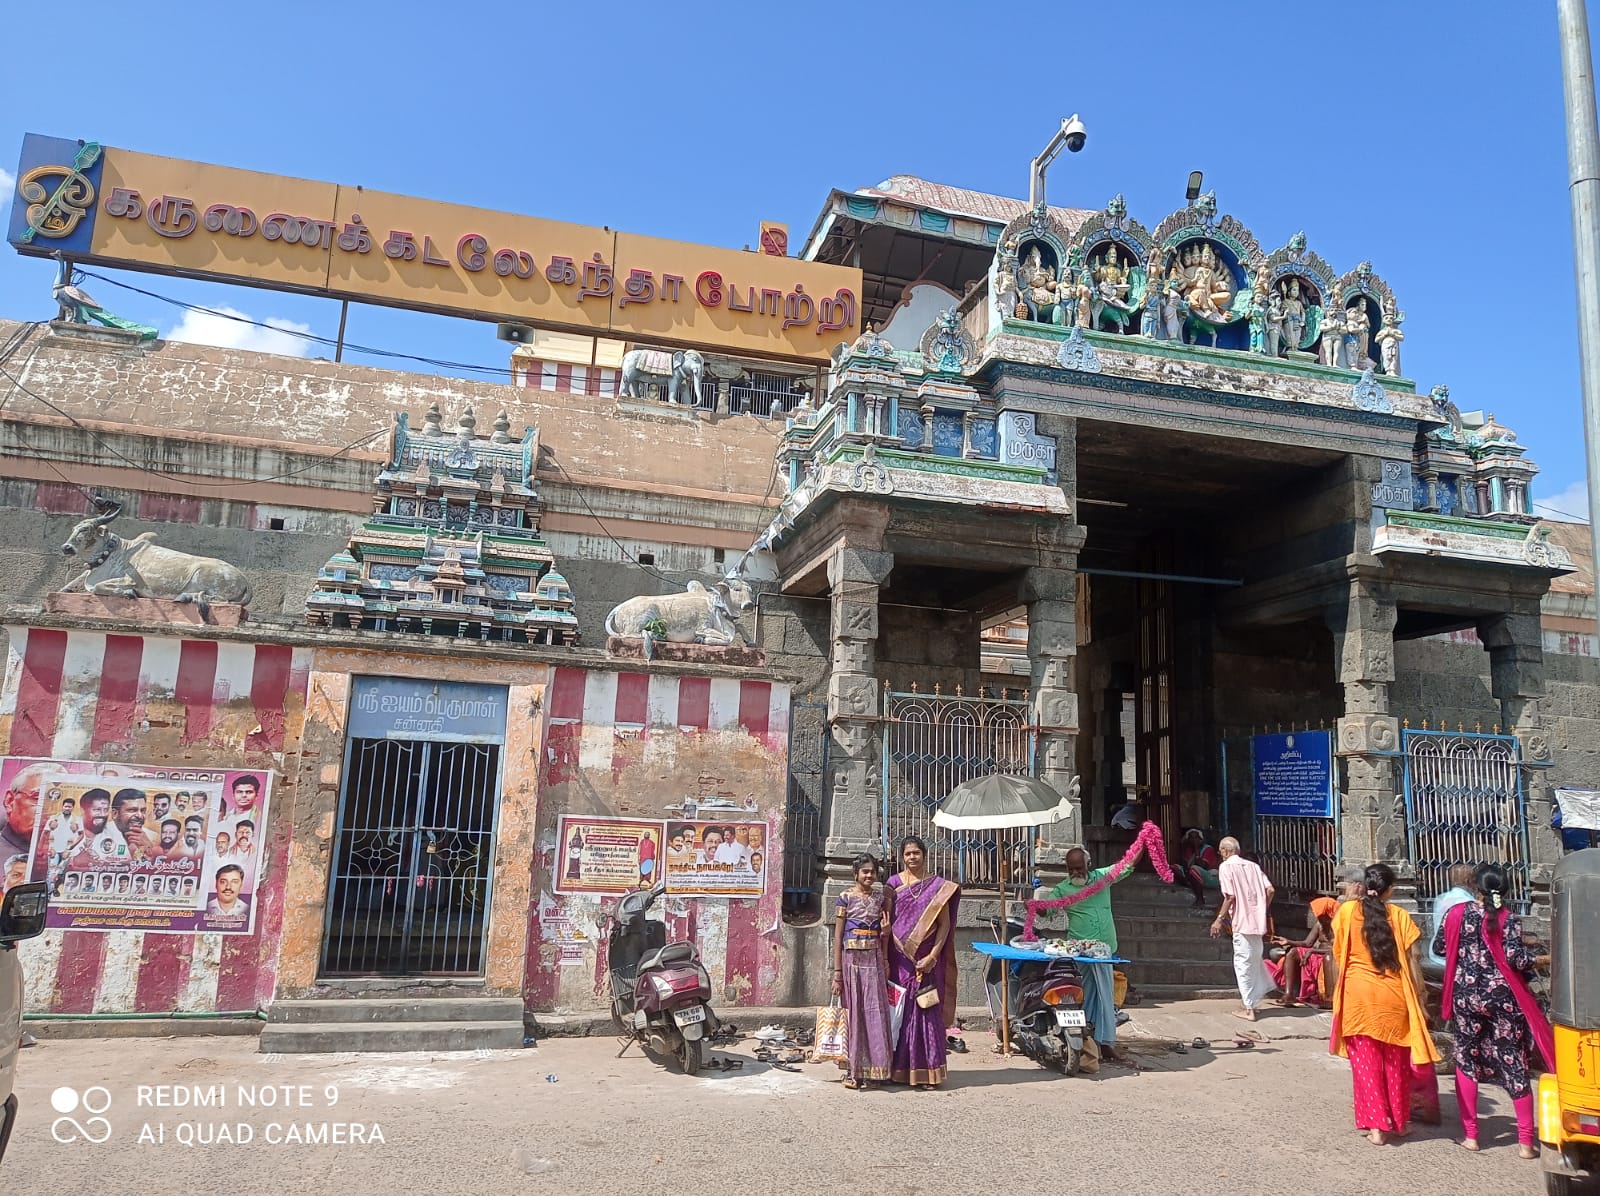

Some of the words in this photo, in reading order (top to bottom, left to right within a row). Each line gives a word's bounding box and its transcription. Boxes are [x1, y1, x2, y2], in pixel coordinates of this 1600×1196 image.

[104, 186, 372, 254] கருணைக்
[382, 229, 535, 279] கடலே
[545, 251, 684, 308] கந்தா
[695, 270, 855, 335] போற்றி
[1007, 440, 1056, 460] முருகா
[1371, 483, 1409, 503] முருகா
